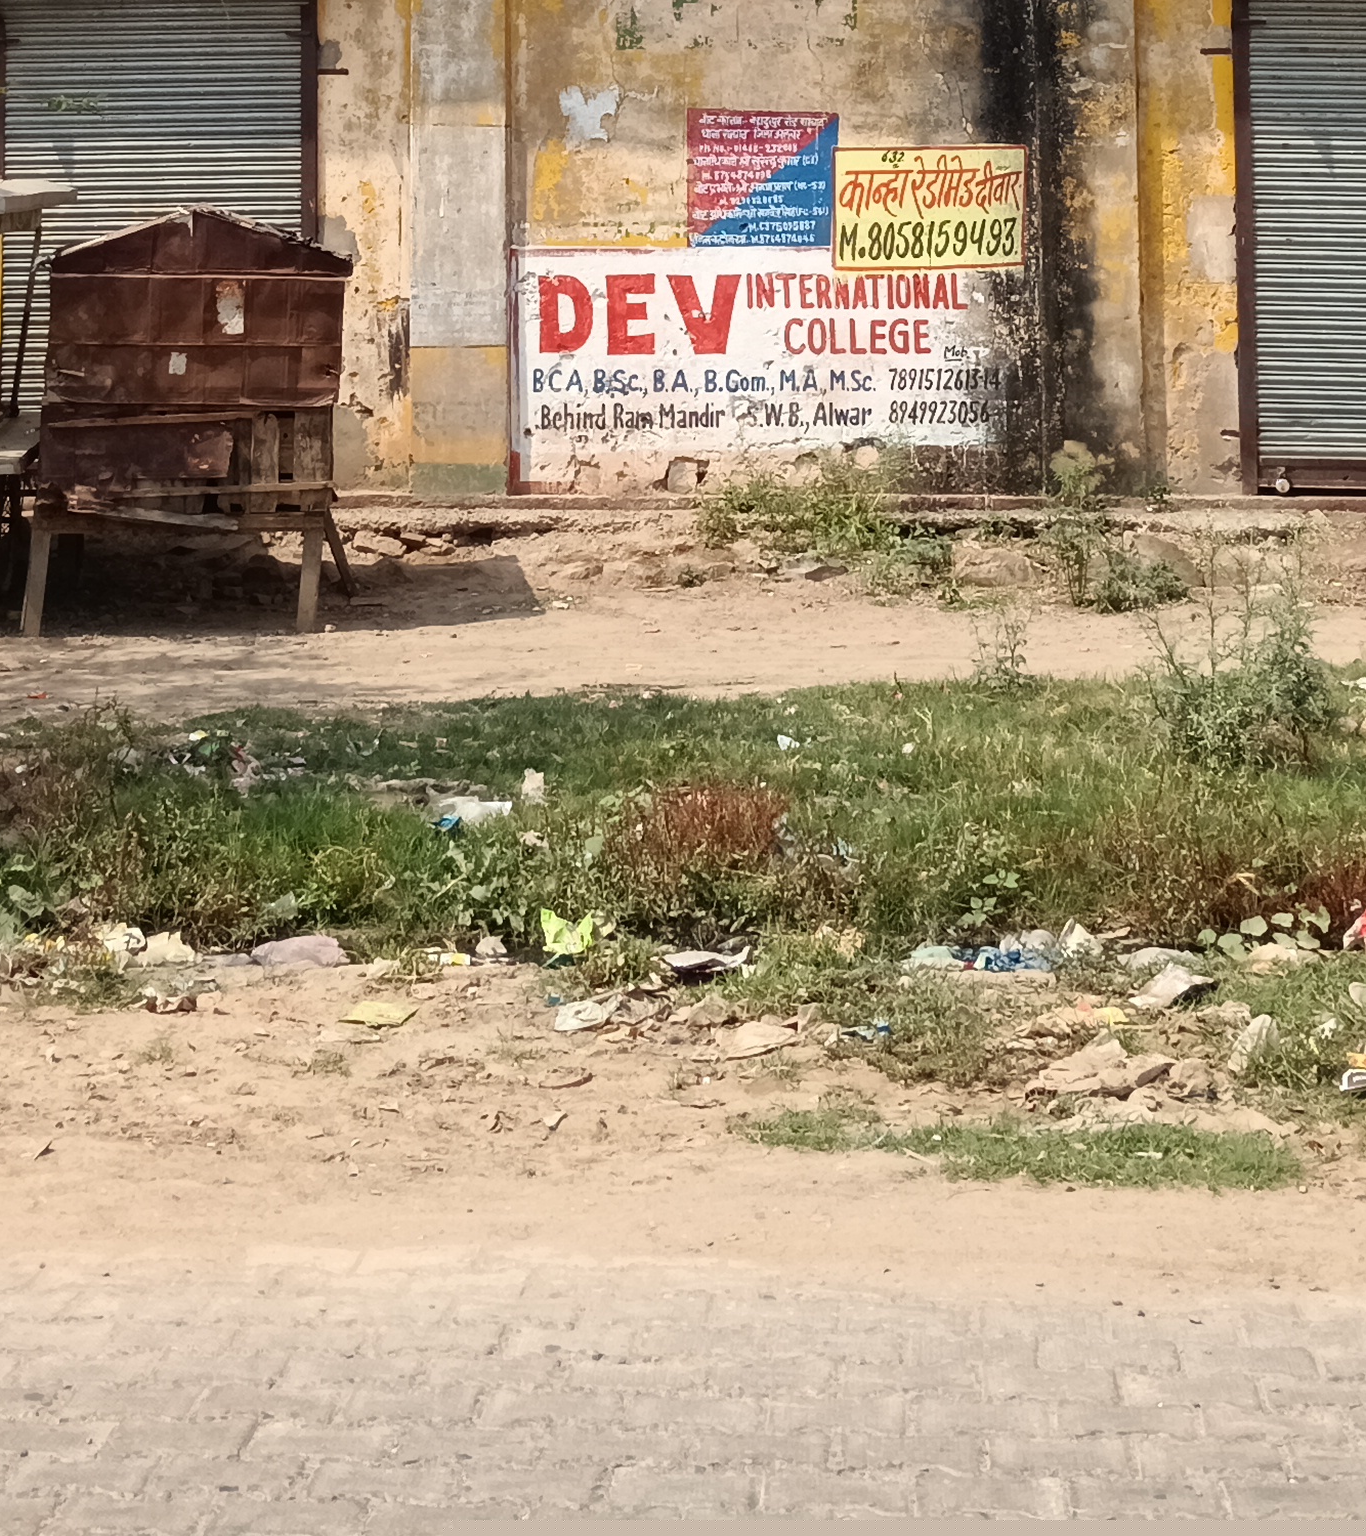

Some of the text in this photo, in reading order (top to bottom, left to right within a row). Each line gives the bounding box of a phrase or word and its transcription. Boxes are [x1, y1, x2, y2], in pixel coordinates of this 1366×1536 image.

[839, 154, 1023, 220] कान्हा रेडीमेड दीवार
[538, 272, 969, 356] DEV INTERNATIONAL
[784, 317, 932, 355] COLLEGE
[829, 368, 877, 392] M.Sc.
[540, 402, 606, 432] Behind
[658, 402, 726, 430] Mandir
[812, 401, 873, 427] Alwar
